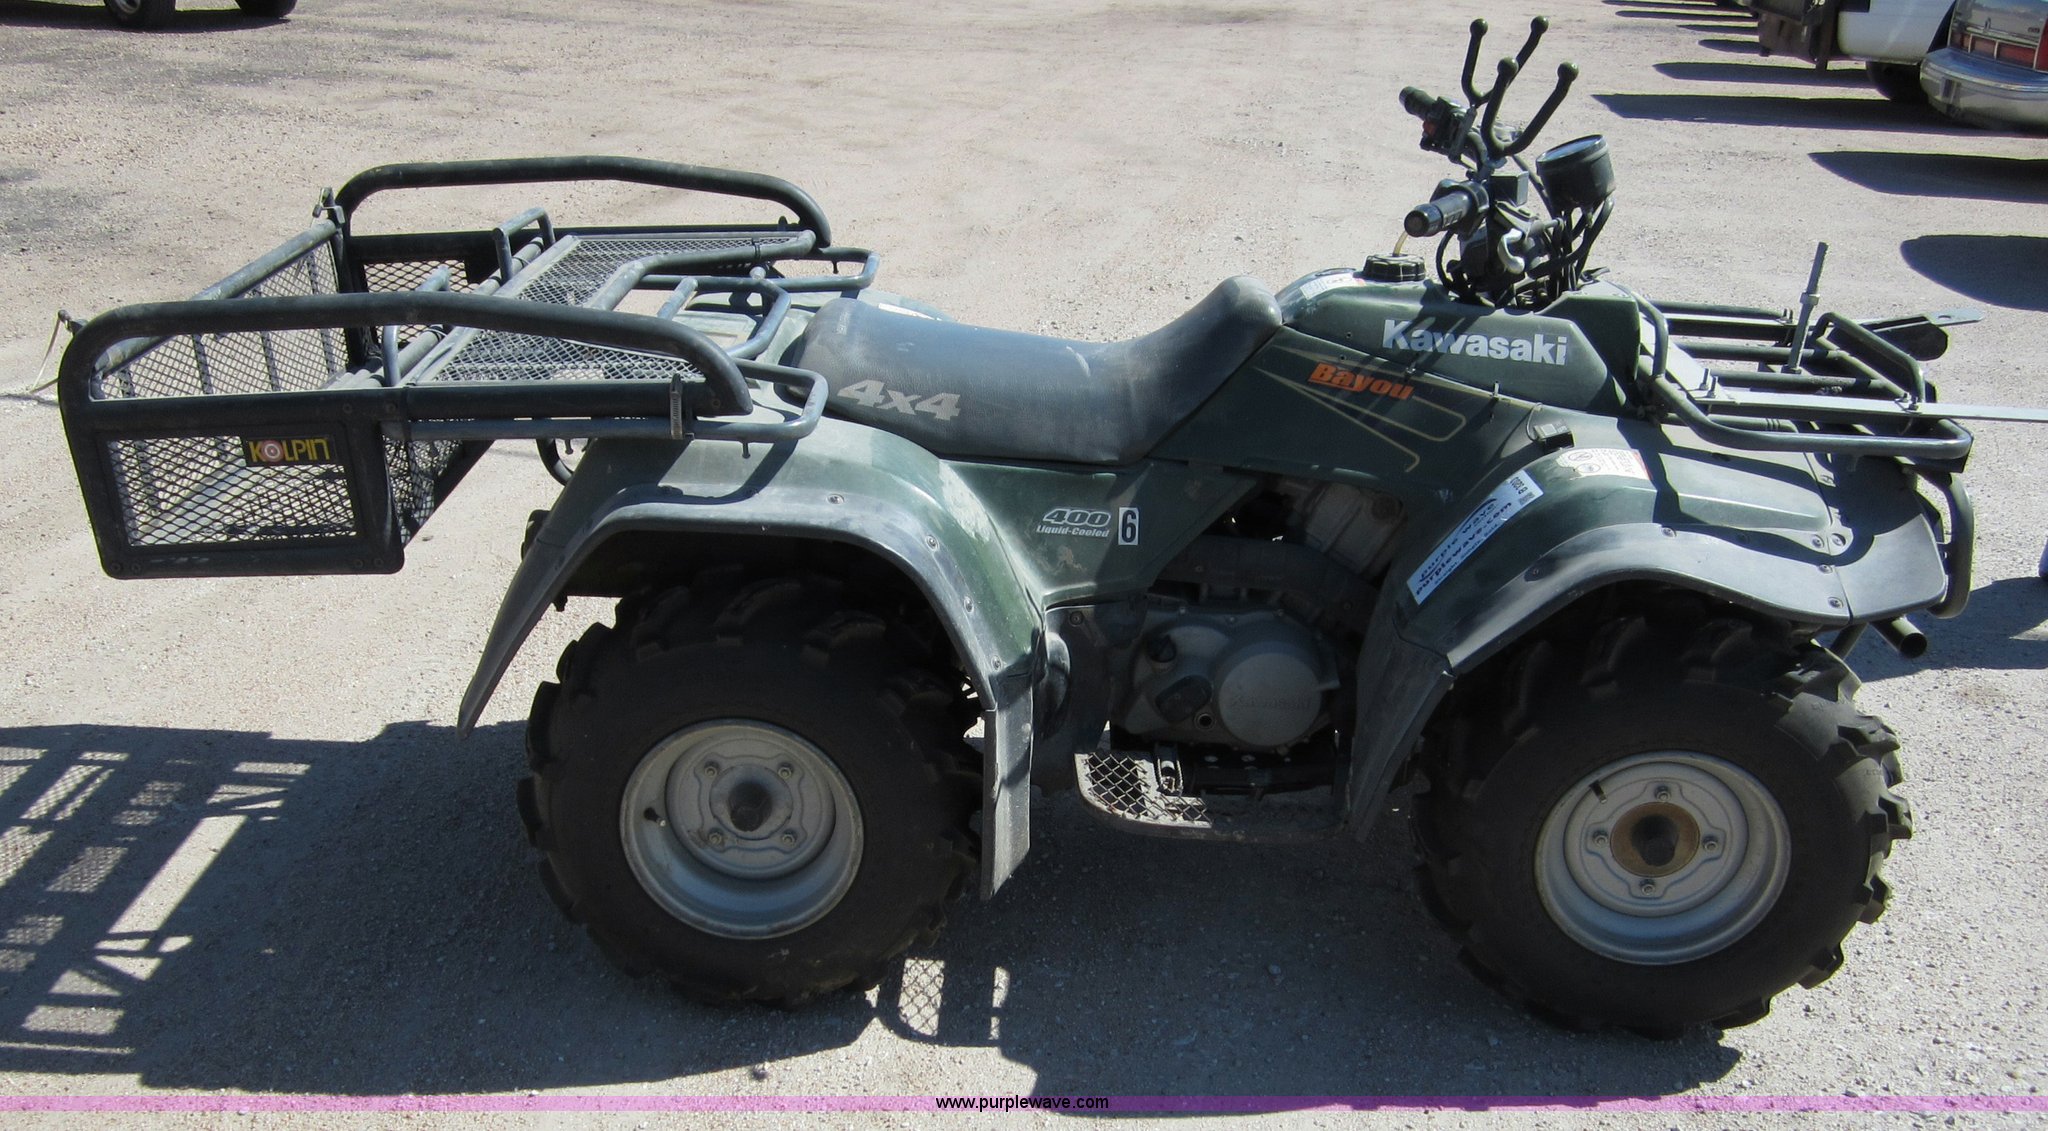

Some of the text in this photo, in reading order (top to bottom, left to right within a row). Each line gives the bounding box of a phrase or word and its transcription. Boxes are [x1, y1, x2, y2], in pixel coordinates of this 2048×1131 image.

[1382, 319, 1568, 365] Kawasaki
[837, 379, 961, 421] 4x4
[1307, 362, 1414, 399] Bayou
[1036, 524, 1110, 538] Liquid-Cooled
[1043, 507, 1112, 527] 400
[1121, 510, 1138, 543] 6
[1416, 502, 1512, 595] purplewave.com
[1420, 538, 1458, 580] purple
[1462, 503, 1496, 534] wave
